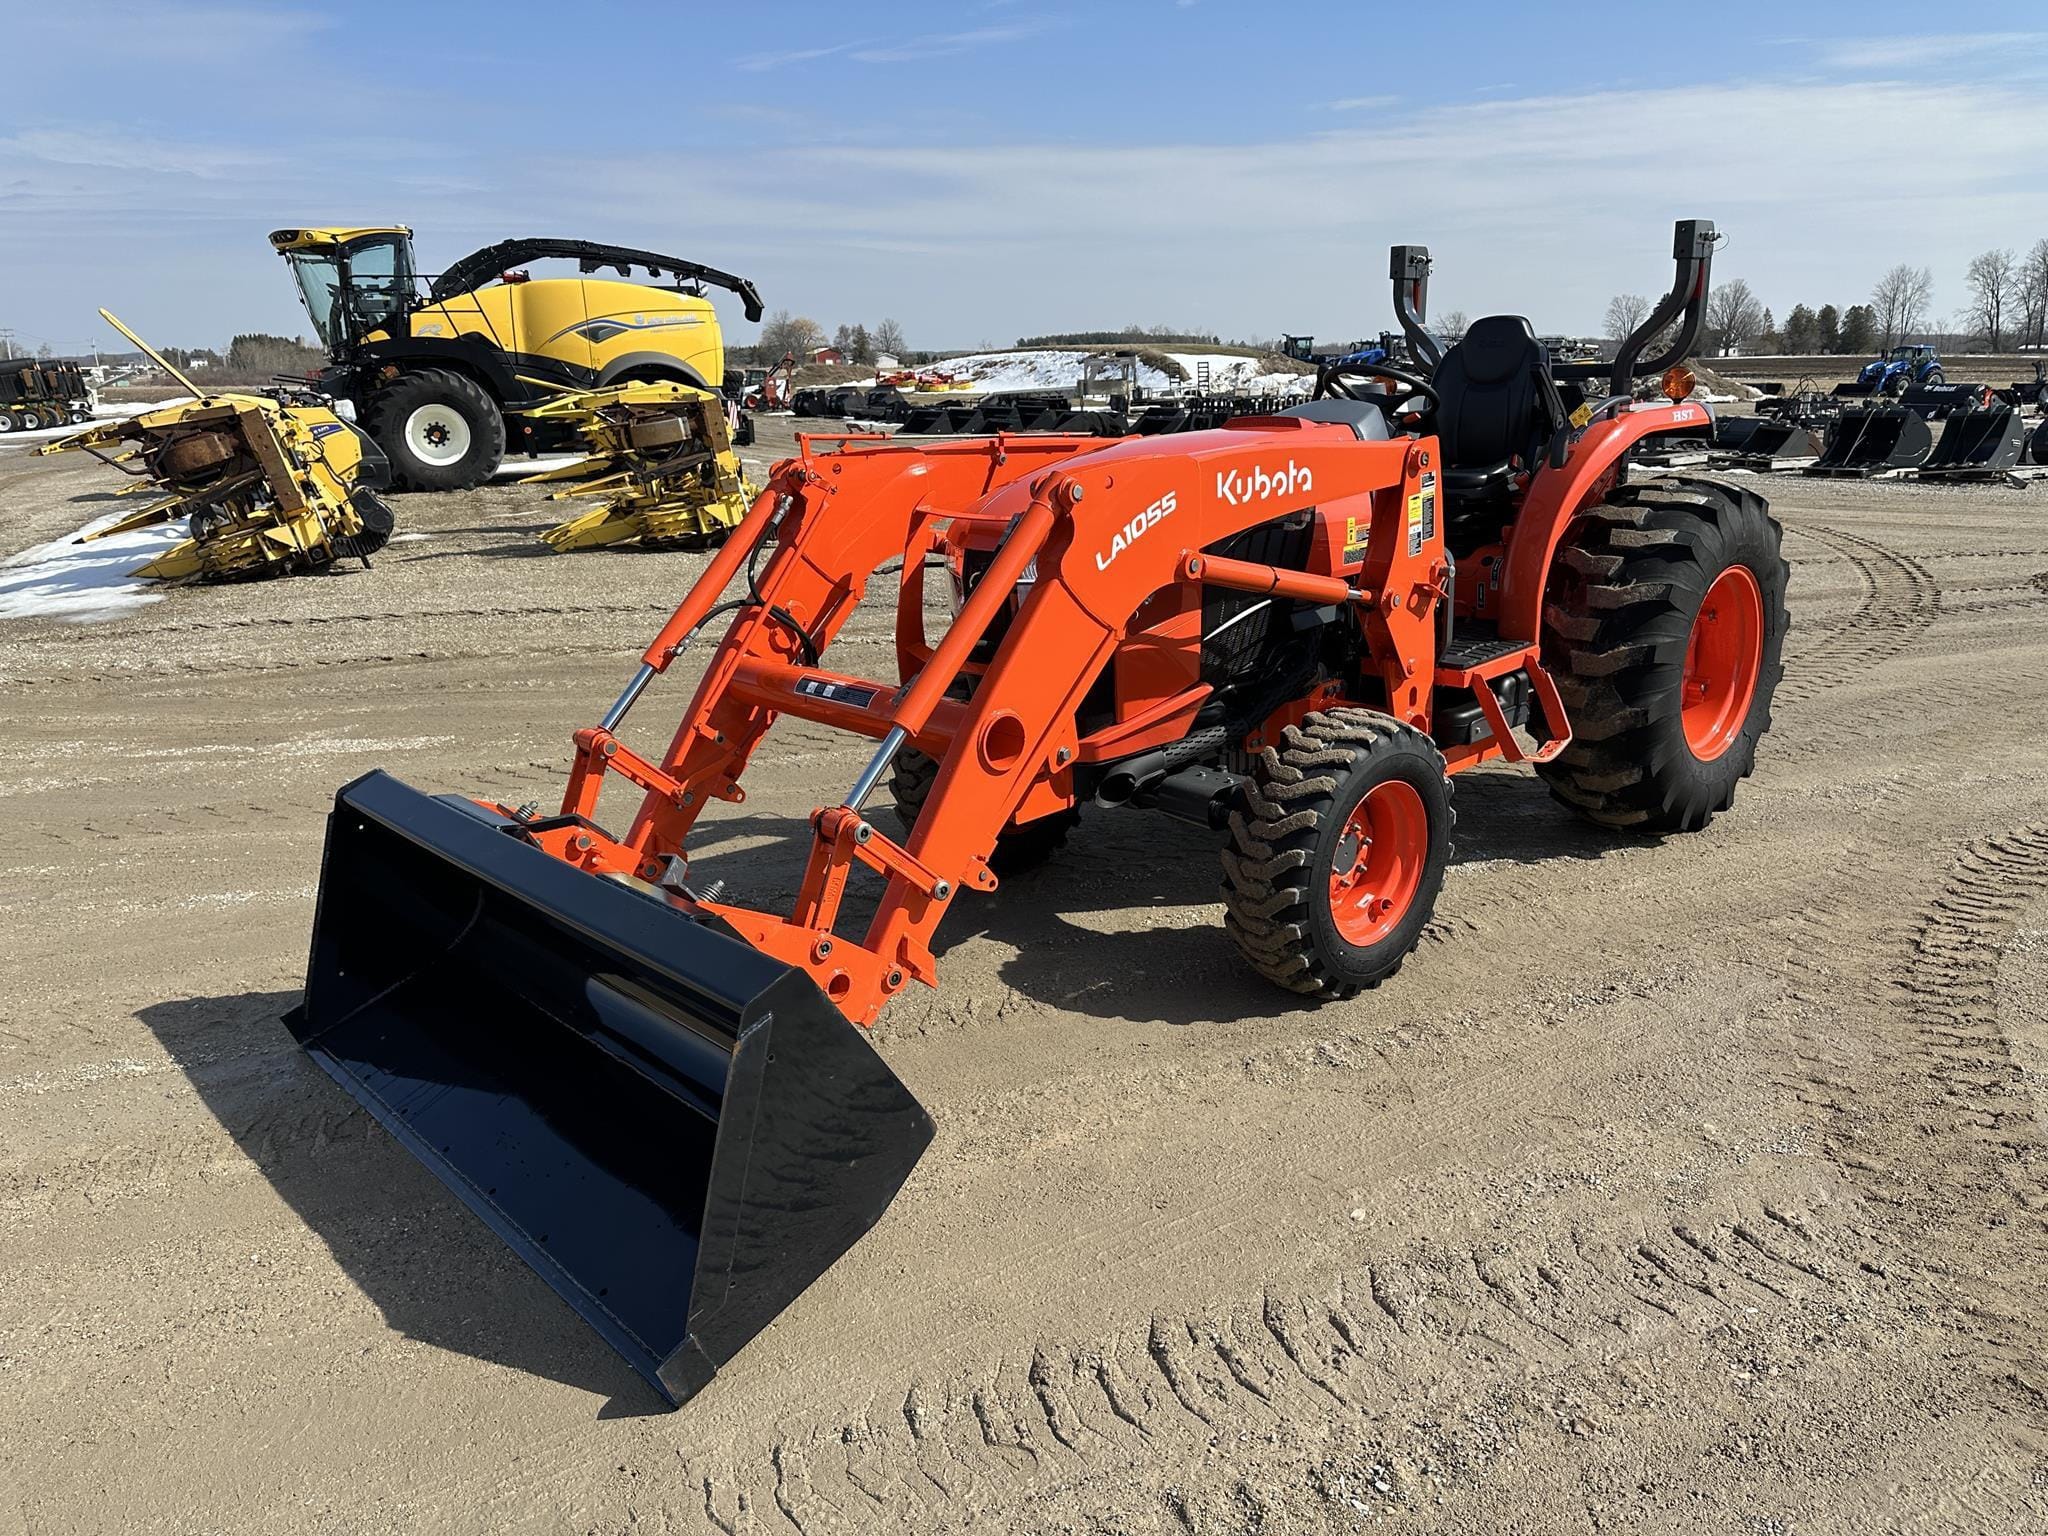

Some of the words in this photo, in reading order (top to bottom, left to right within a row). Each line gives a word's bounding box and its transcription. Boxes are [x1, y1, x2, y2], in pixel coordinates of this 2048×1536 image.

[1672, 409, 1695, 422] HST
[1216, 459, 1313, 506] Kubota
[1095, 490, 1177, 571] LA1055
